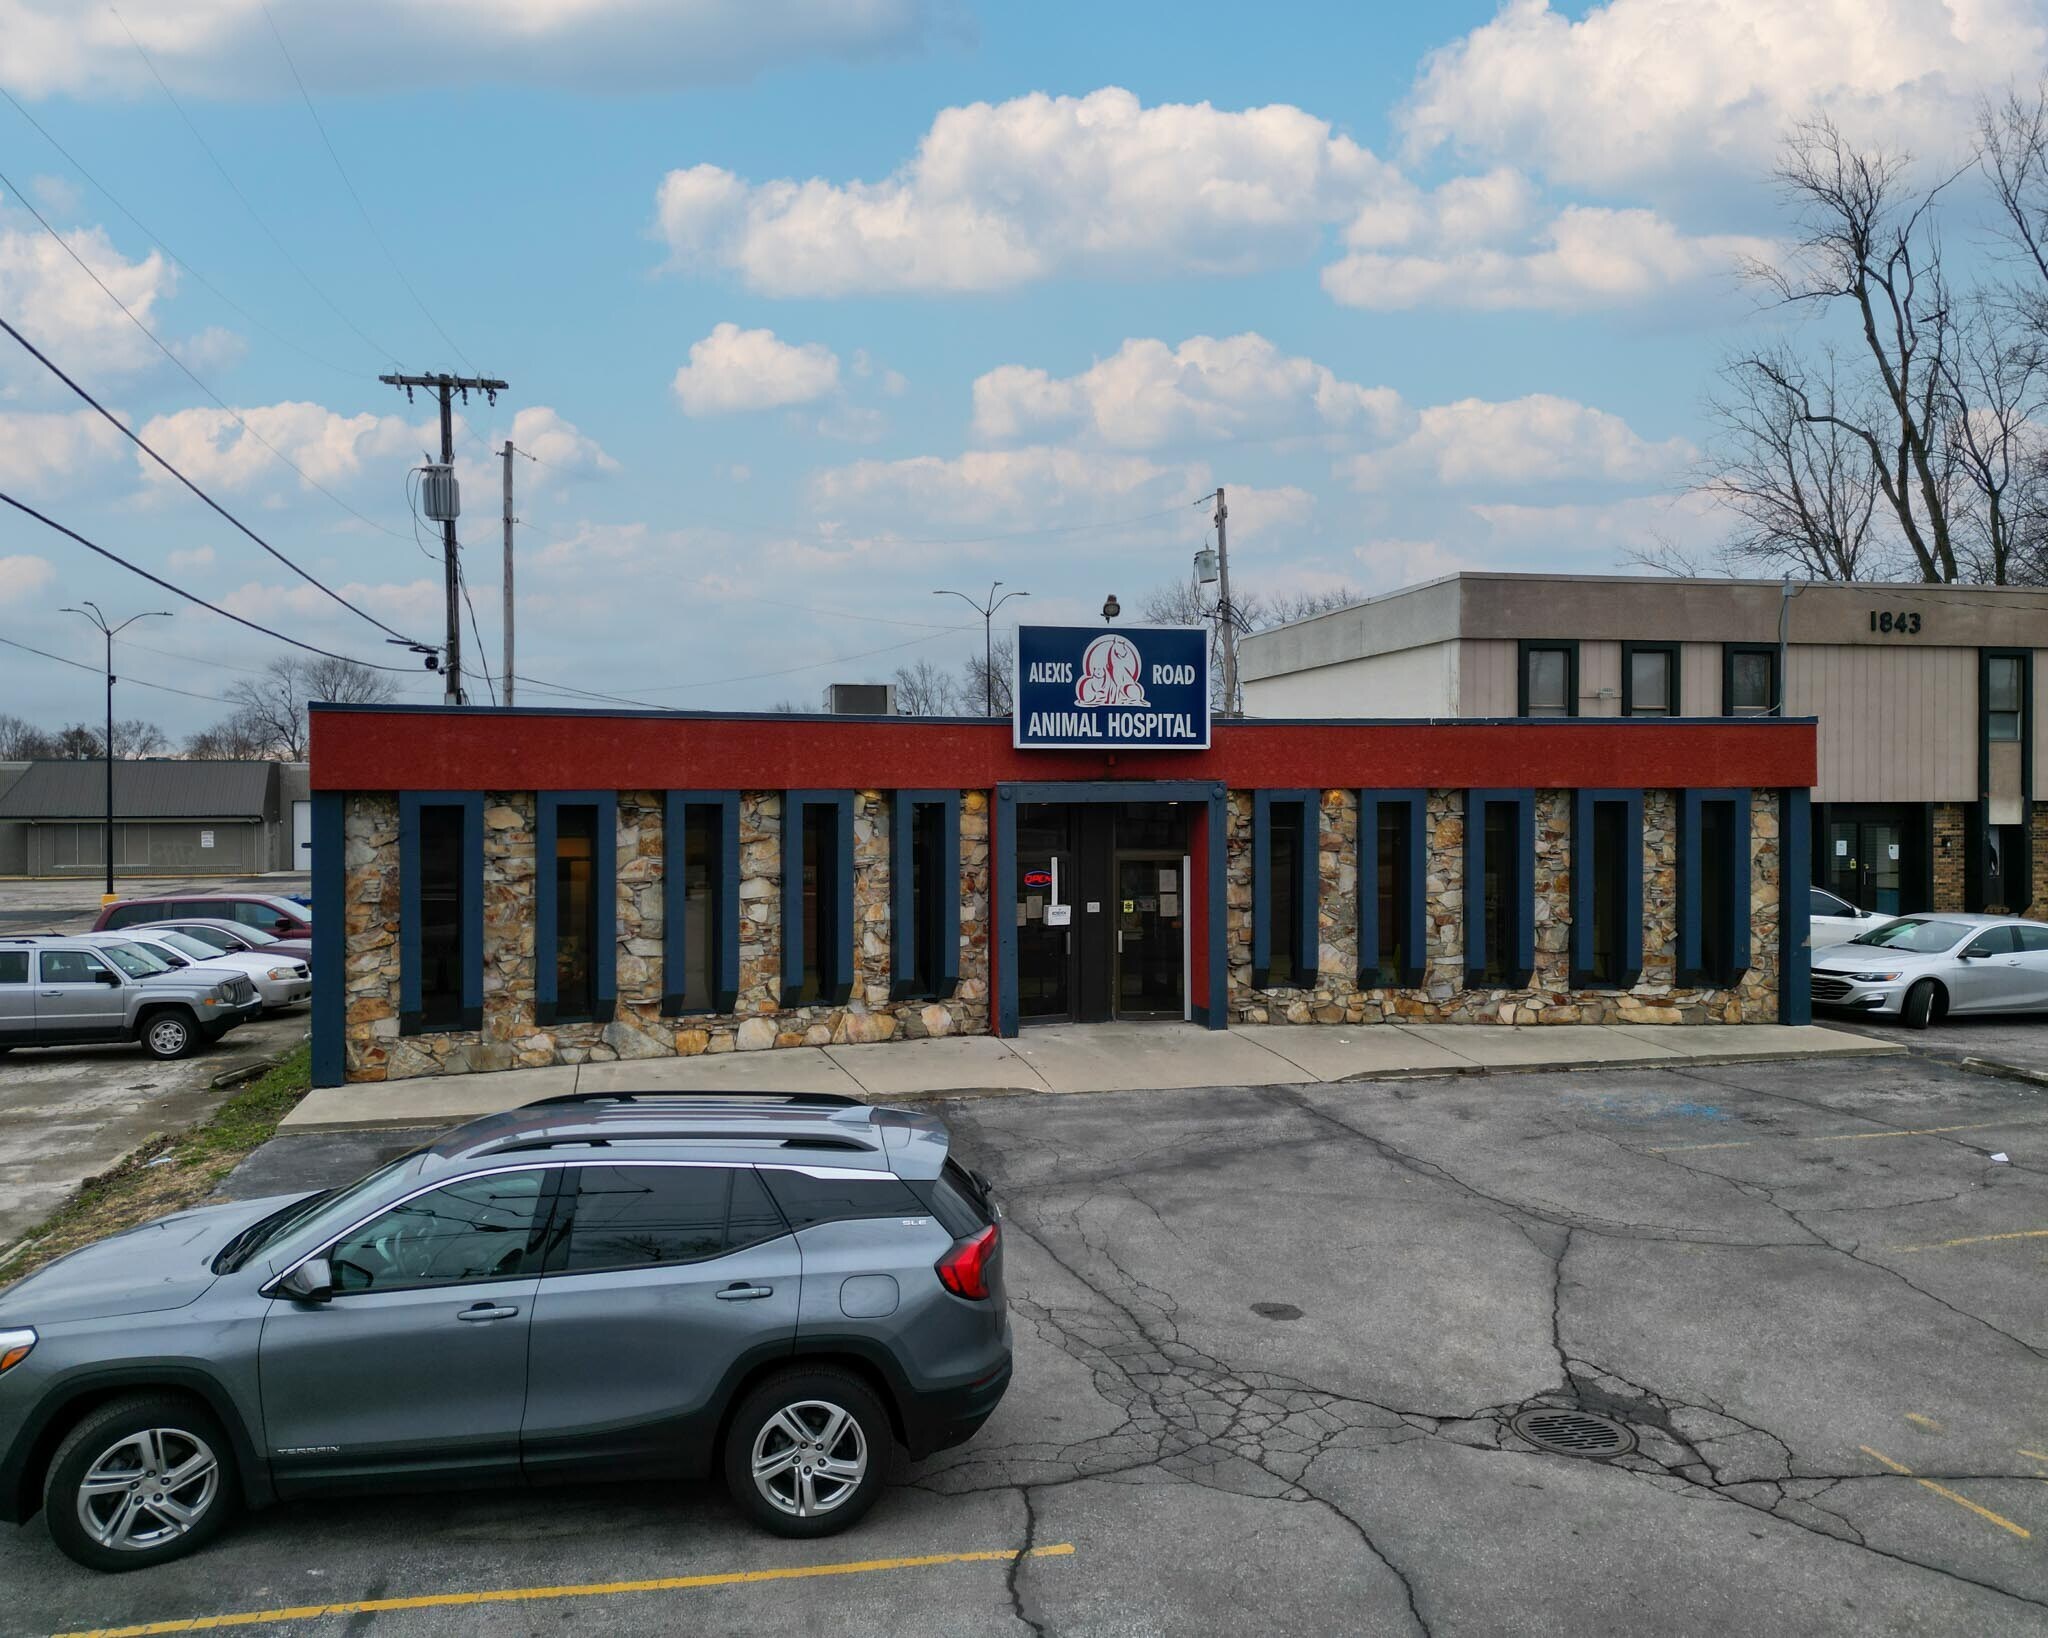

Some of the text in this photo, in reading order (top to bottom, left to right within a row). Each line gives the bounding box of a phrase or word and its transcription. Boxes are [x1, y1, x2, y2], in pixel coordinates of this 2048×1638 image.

[1870, 610, 1921, 634] 1843
[1029, 662, 1196, 685] ALEXIS ROAD
[1028, 712, 1197, 738] ANIMAL HOSPITAL
[277, 1446, 340, 1456] TERRAIN
